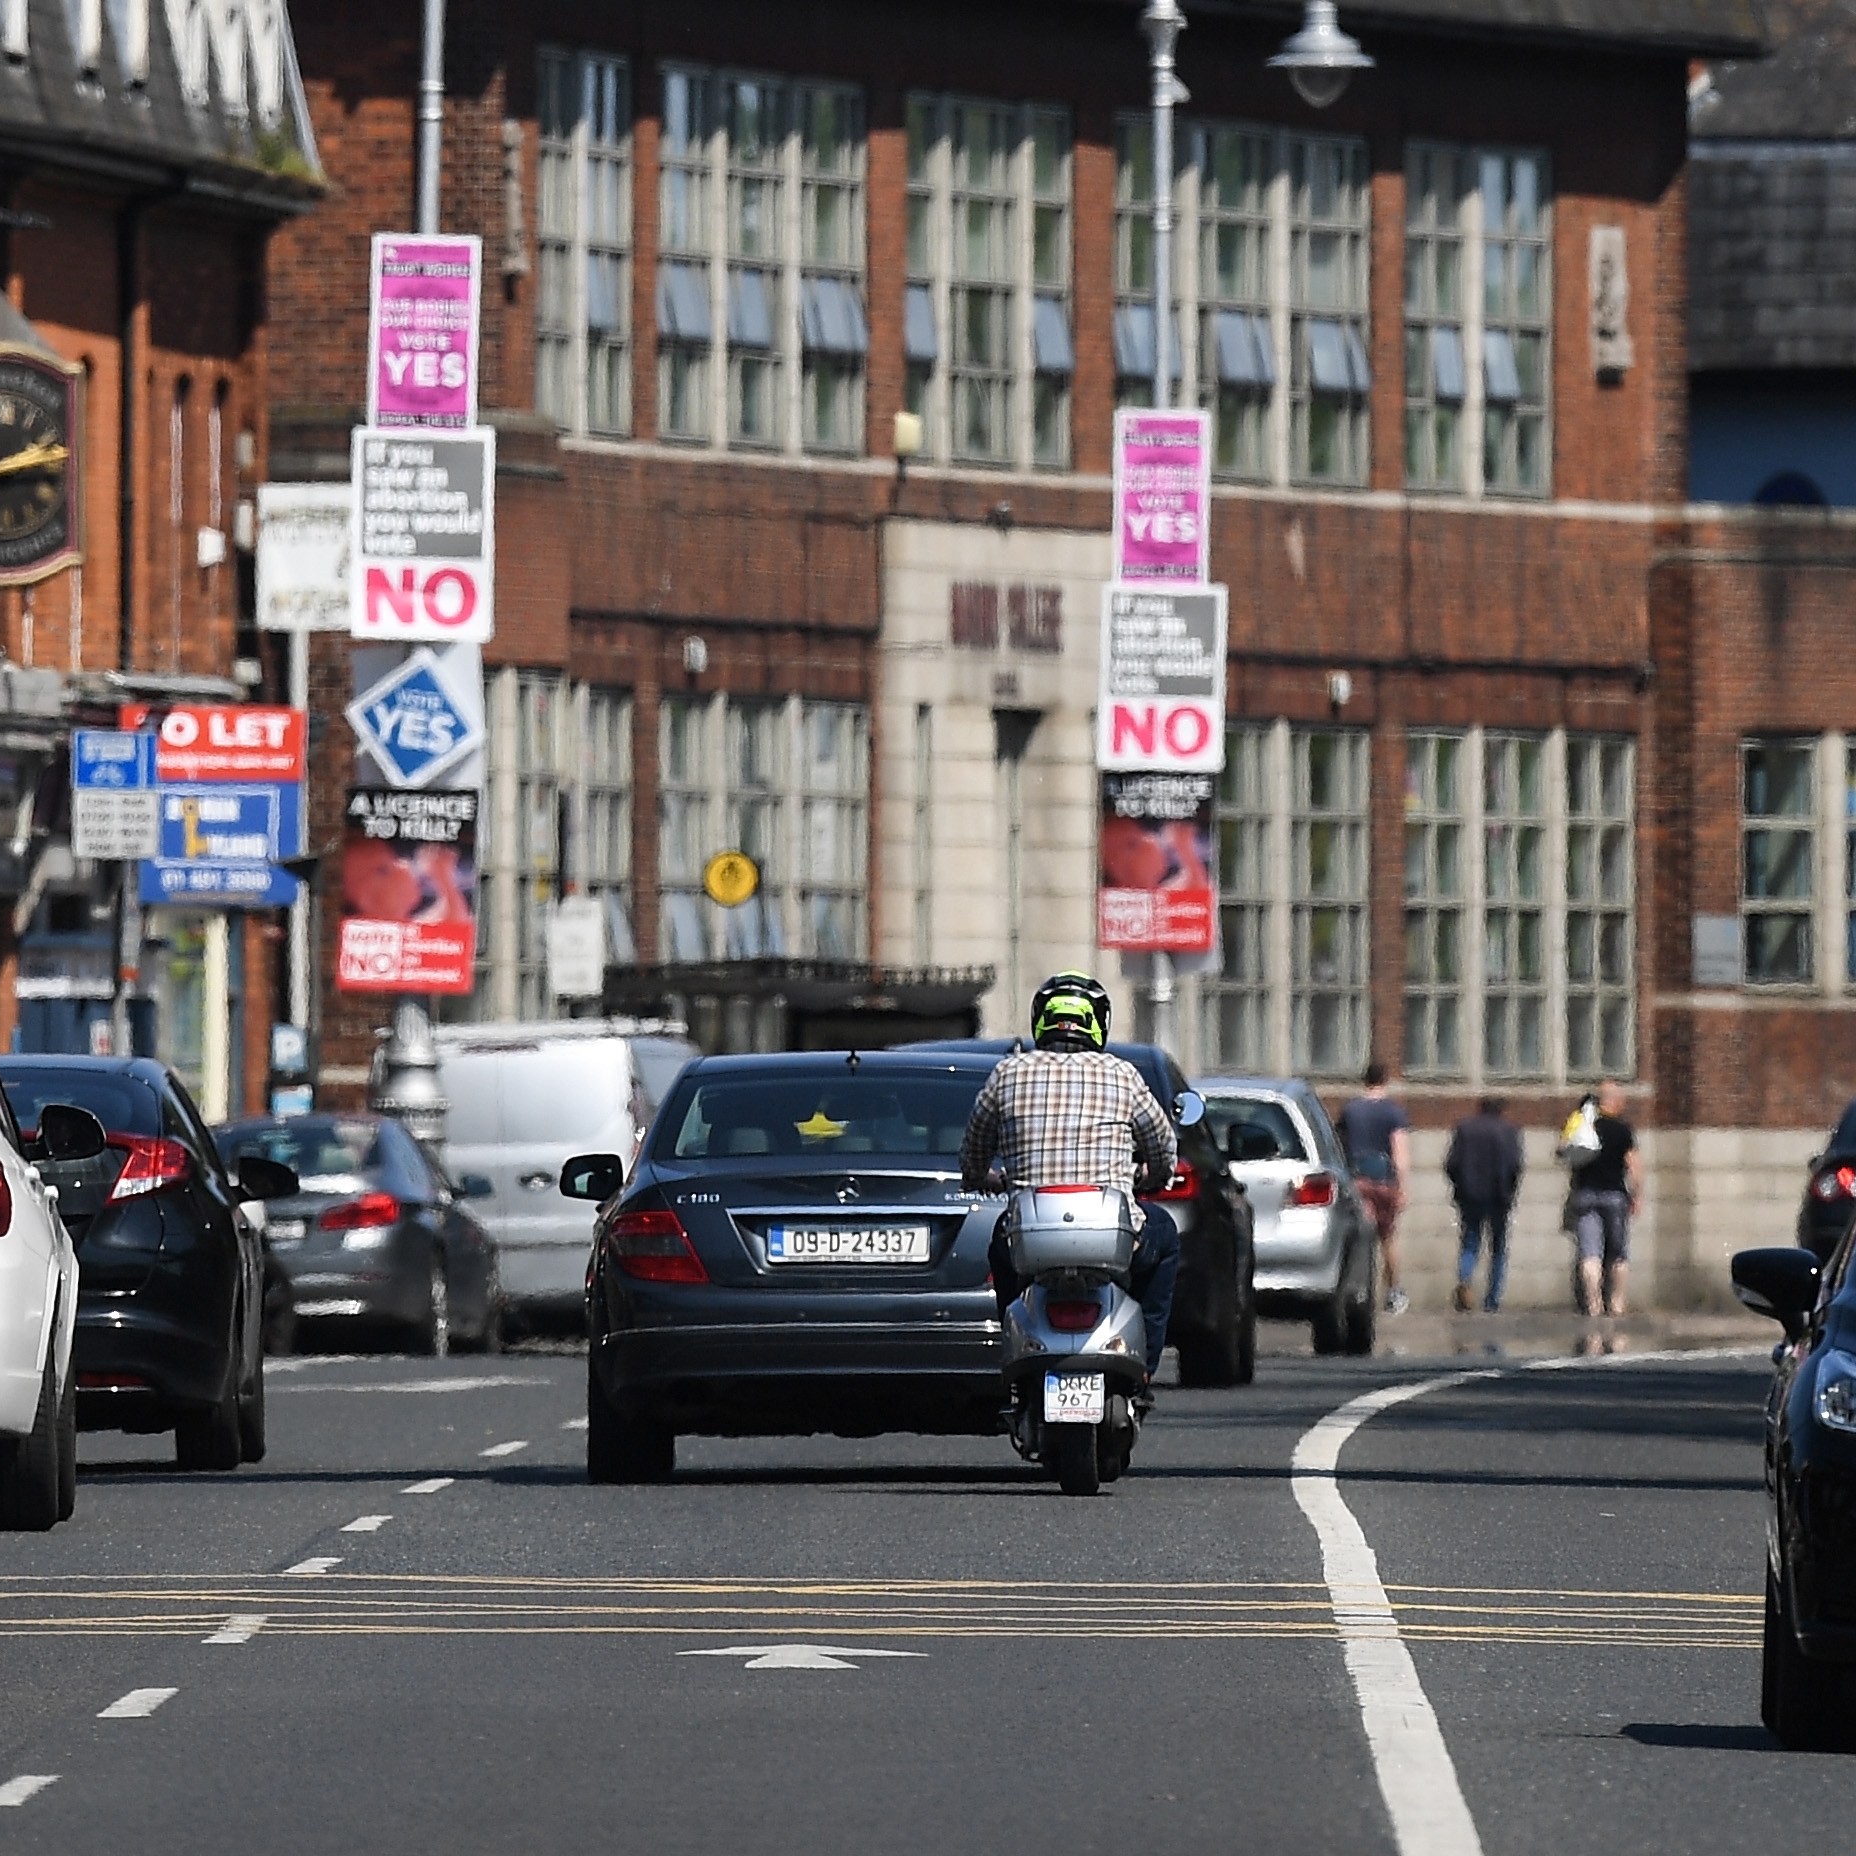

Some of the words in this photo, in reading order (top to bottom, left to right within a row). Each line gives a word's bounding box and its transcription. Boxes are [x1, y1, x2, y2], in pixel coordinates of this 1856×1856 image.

[383, 350, 467, 389] YES
[389, 446, 434, 468] you
[364, 489, 469, 511] abortion
[364, 511, 410, 535] you
[410, 508, 483, 533] would
[1126, 512, 1198, 542] YES
[365, 567, 477, 625] NO
[208, 712, 291, 748] LET
[375, 703, 458, 754] YES
[1111, 705, 1211, 757] NO
[348, 795, 371, 815] A
[364, 819, 398, 839] TO
[793, 1230, 917, 1255] 09-D-24337
[1057, 1392, 1093, 1409] 967
